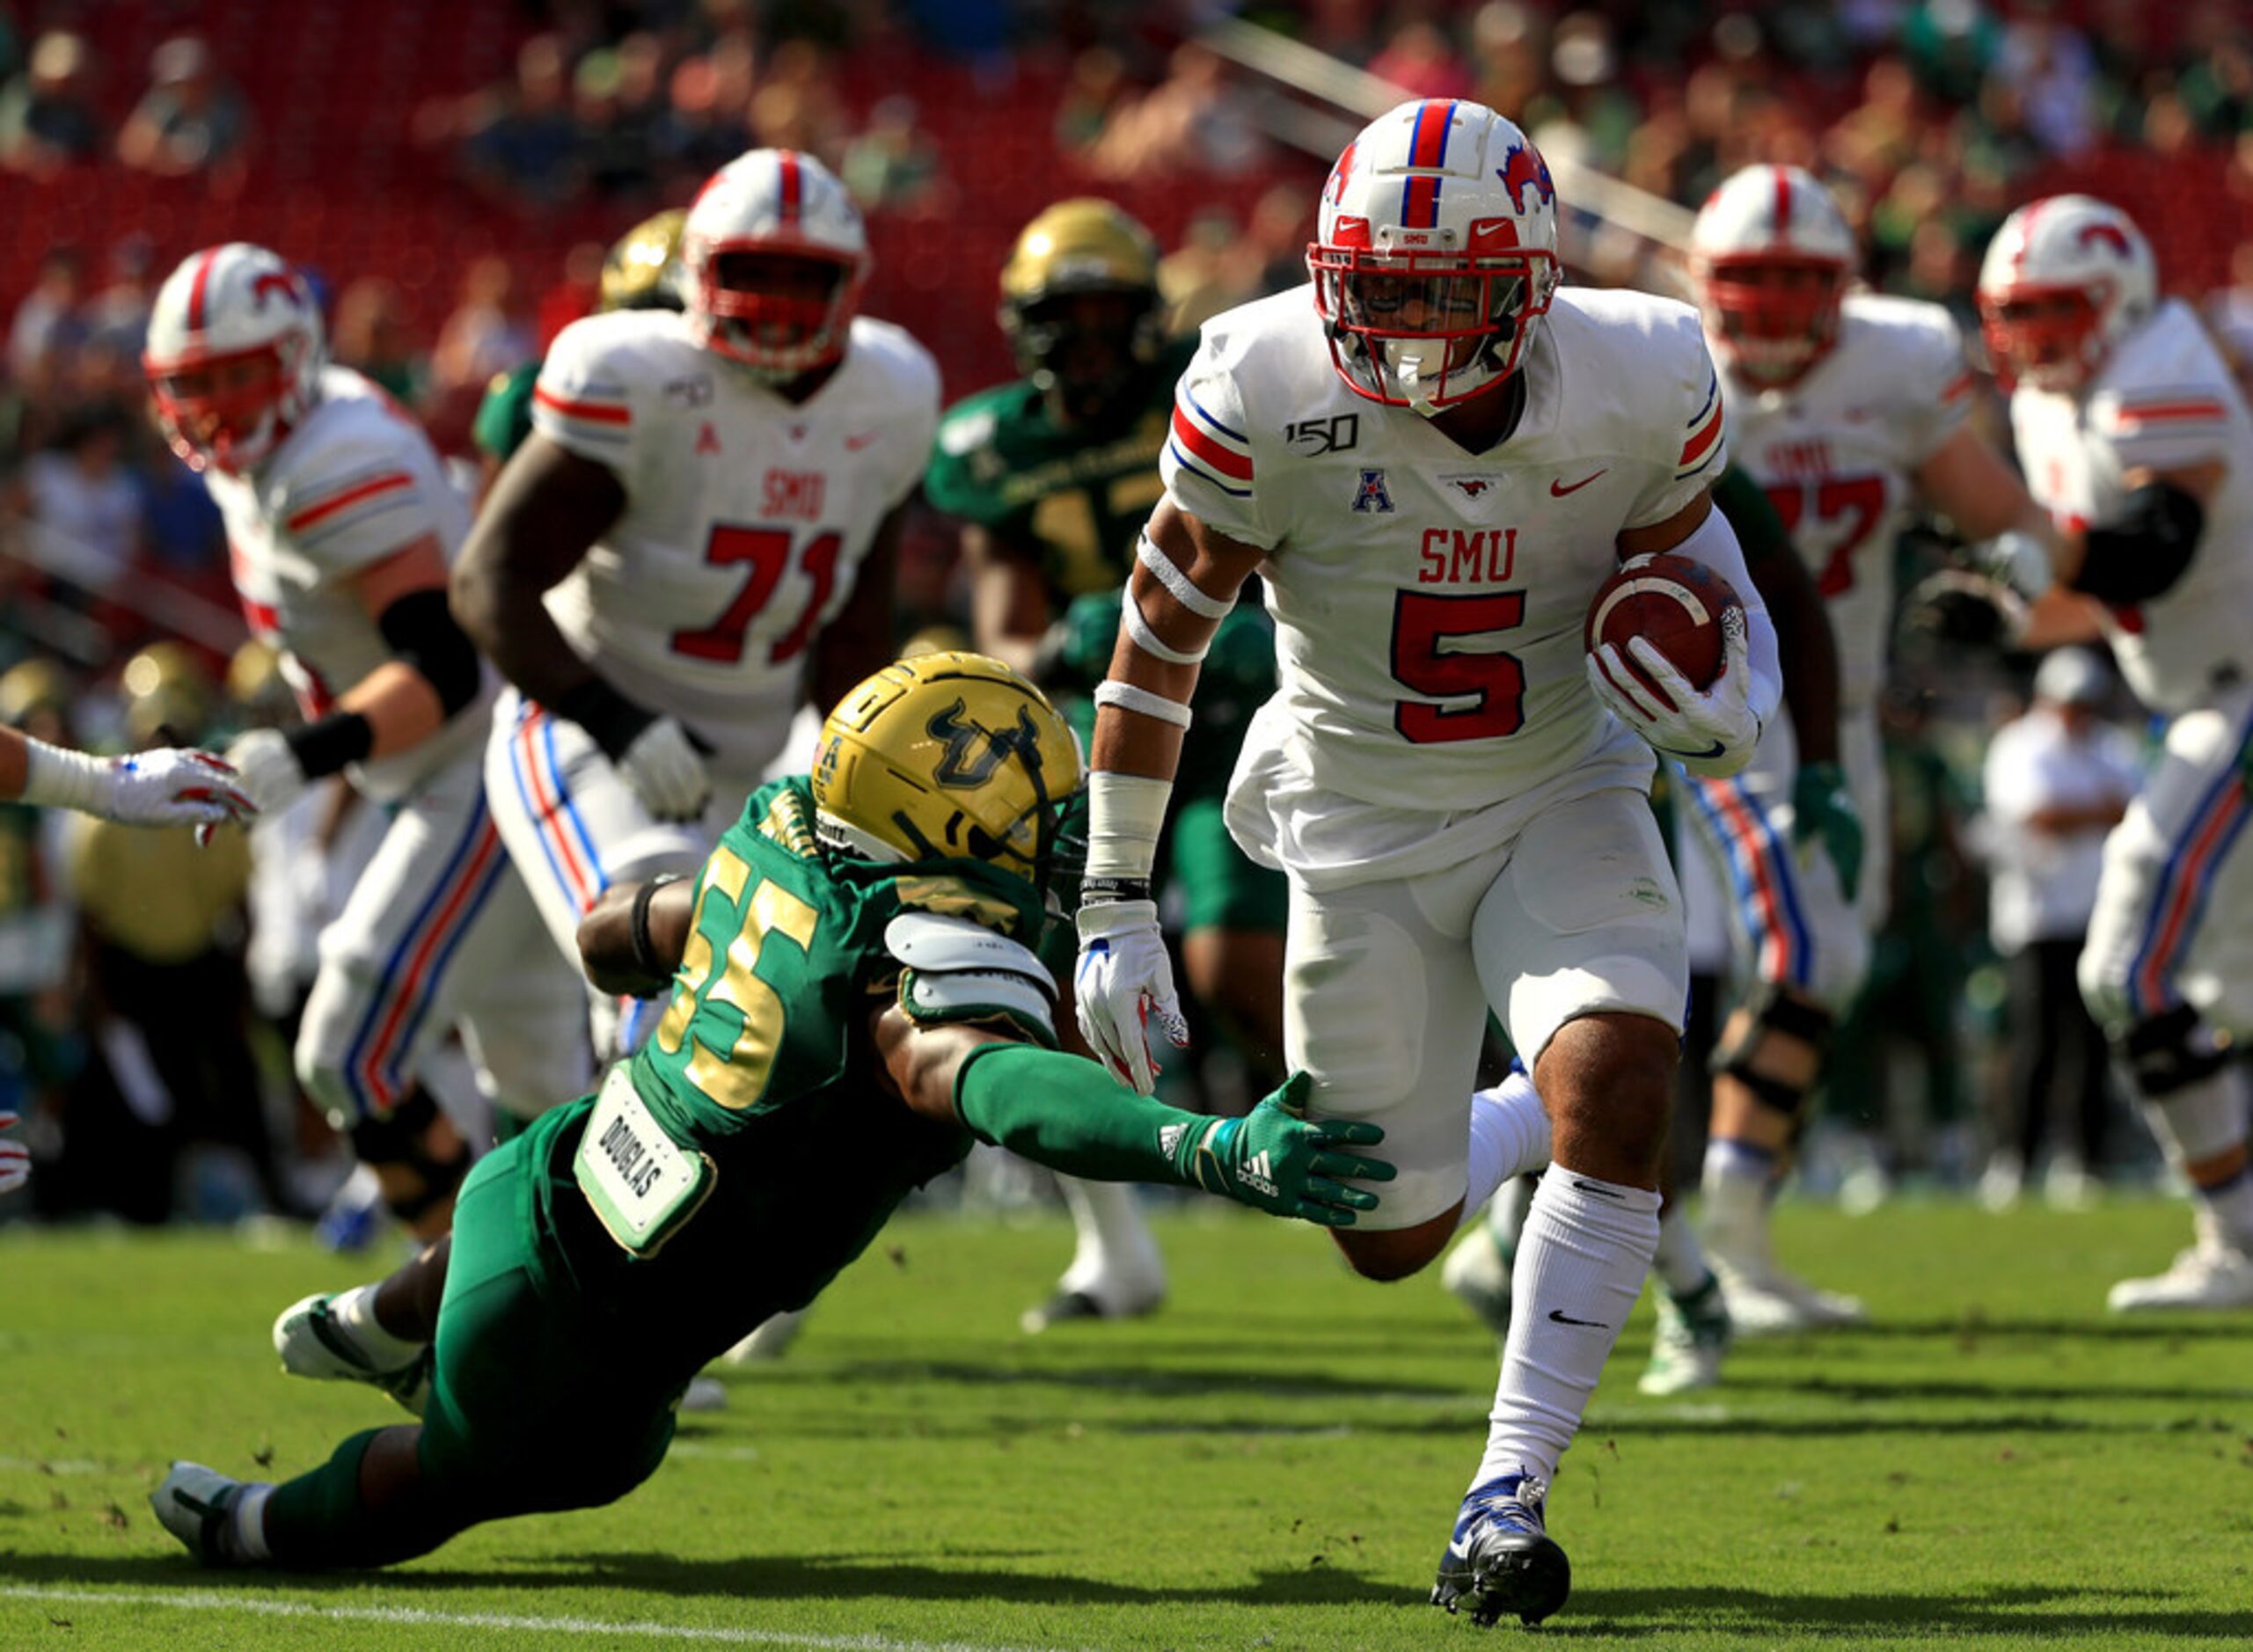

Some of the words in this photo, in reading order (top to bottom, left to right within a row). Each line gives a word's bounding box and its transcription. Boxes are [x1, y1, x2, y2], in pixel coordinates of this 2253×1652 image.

[1284, 413, 1359, 457] 150
[760, 467, 827, 522] SMU
[1352, 468, 1394, 513] A
[1418, 528, 1517, 583] SMU
[668, 523, 845, 669] 71
[1390, 588, 1527, 744] 5
[656, 845, 821, 1110] 55
[598, 1115, 662, 1199] DOUGLAS
[1235, 1168, 1279, 1198] adidas
